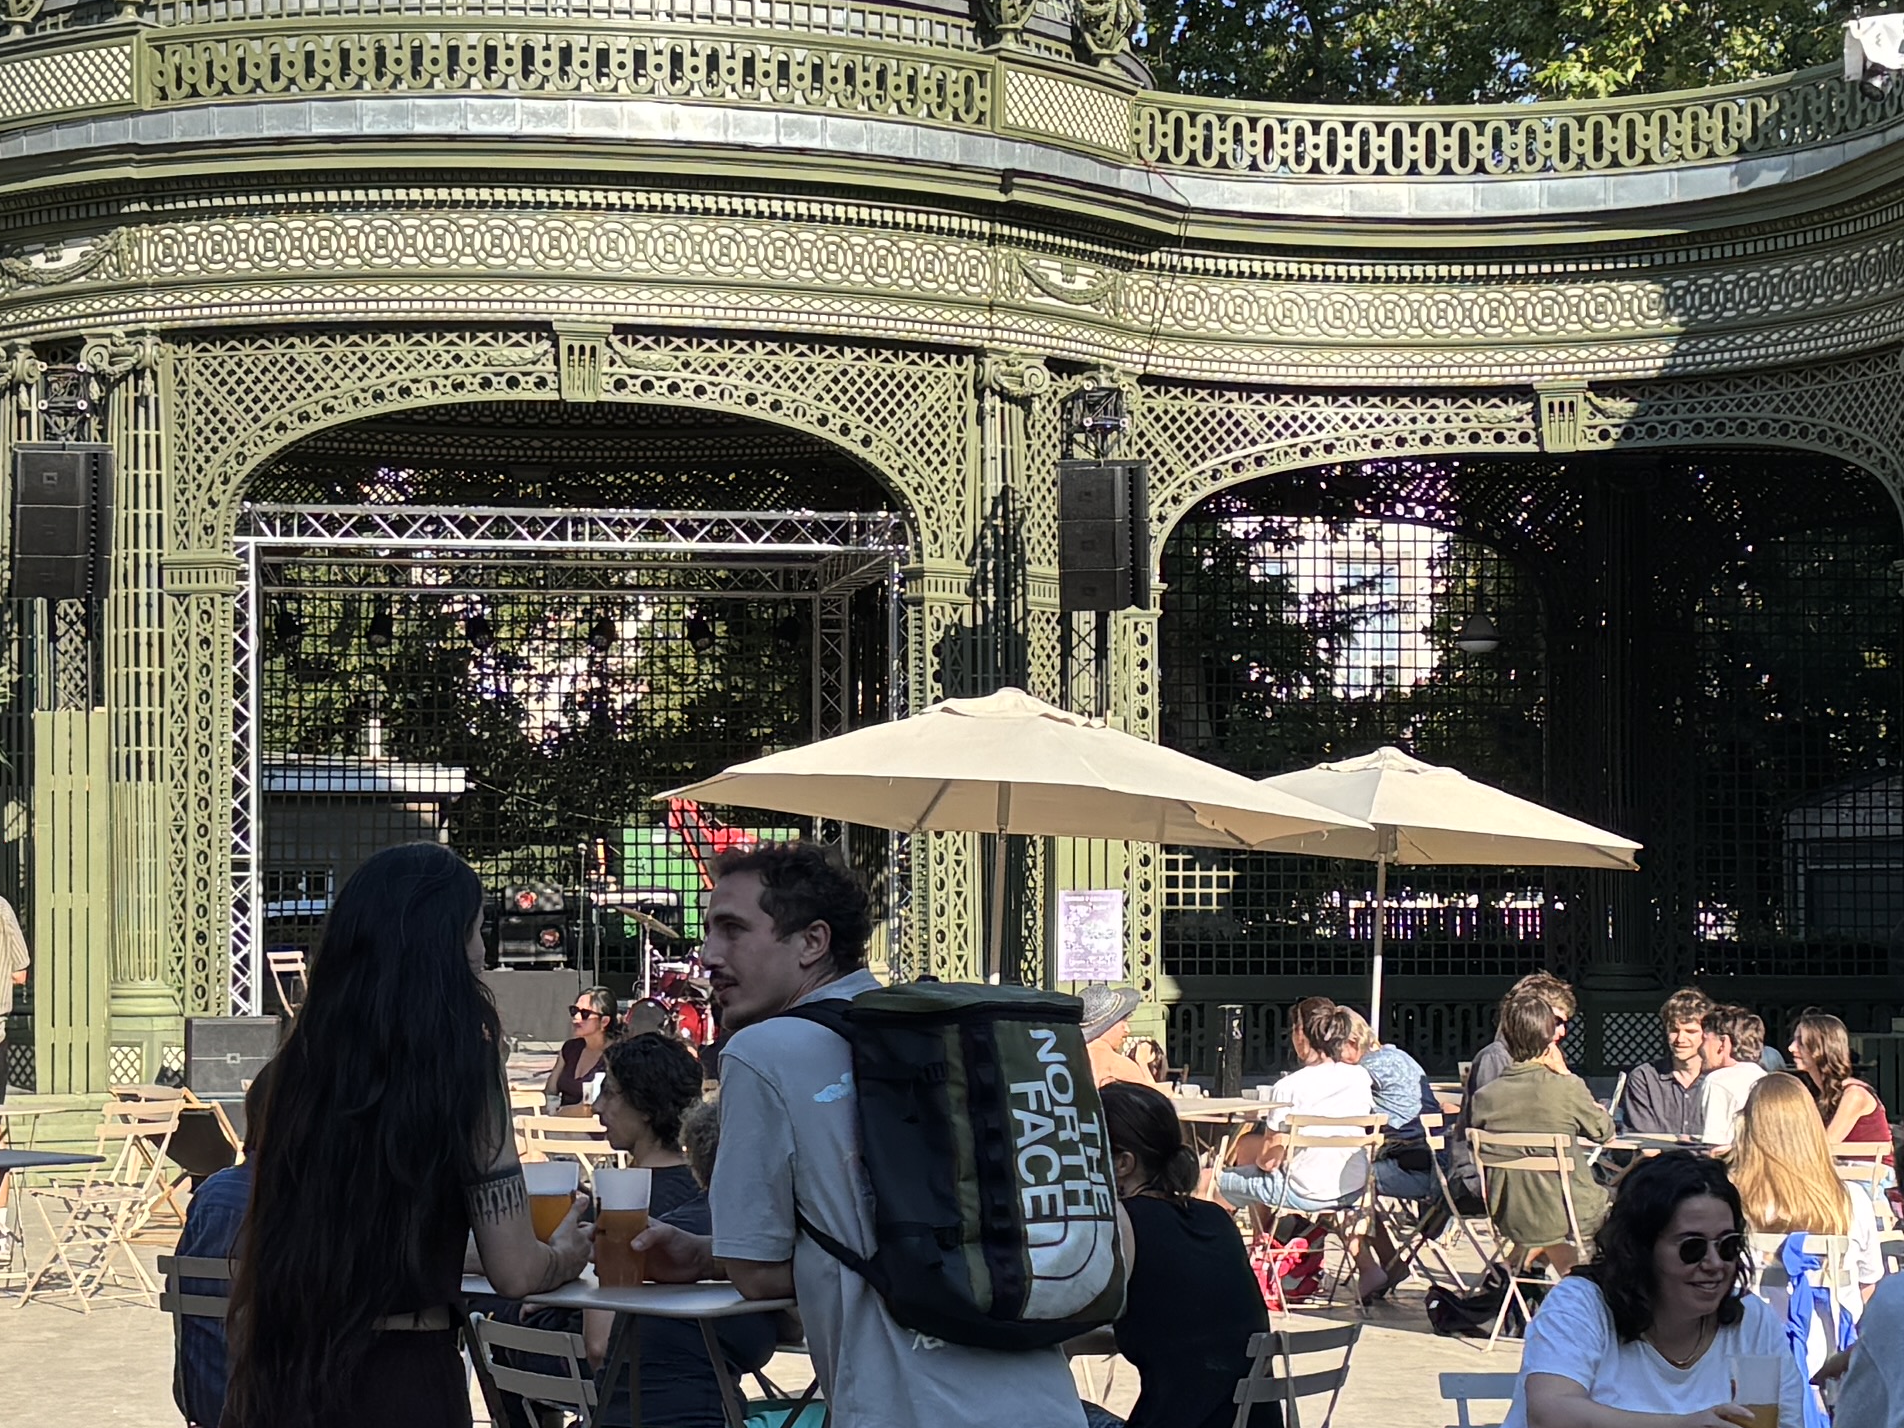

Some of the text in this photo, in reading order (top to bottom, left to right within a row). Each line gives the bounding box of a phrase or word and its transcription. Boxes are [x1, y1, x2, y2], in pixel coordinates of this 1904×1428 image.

[1009, 1080, 1066, 1219] FACE
[1028, 1028, 1096, 1217] NORTH
[1080, 1111, 1114, 1217] THE
